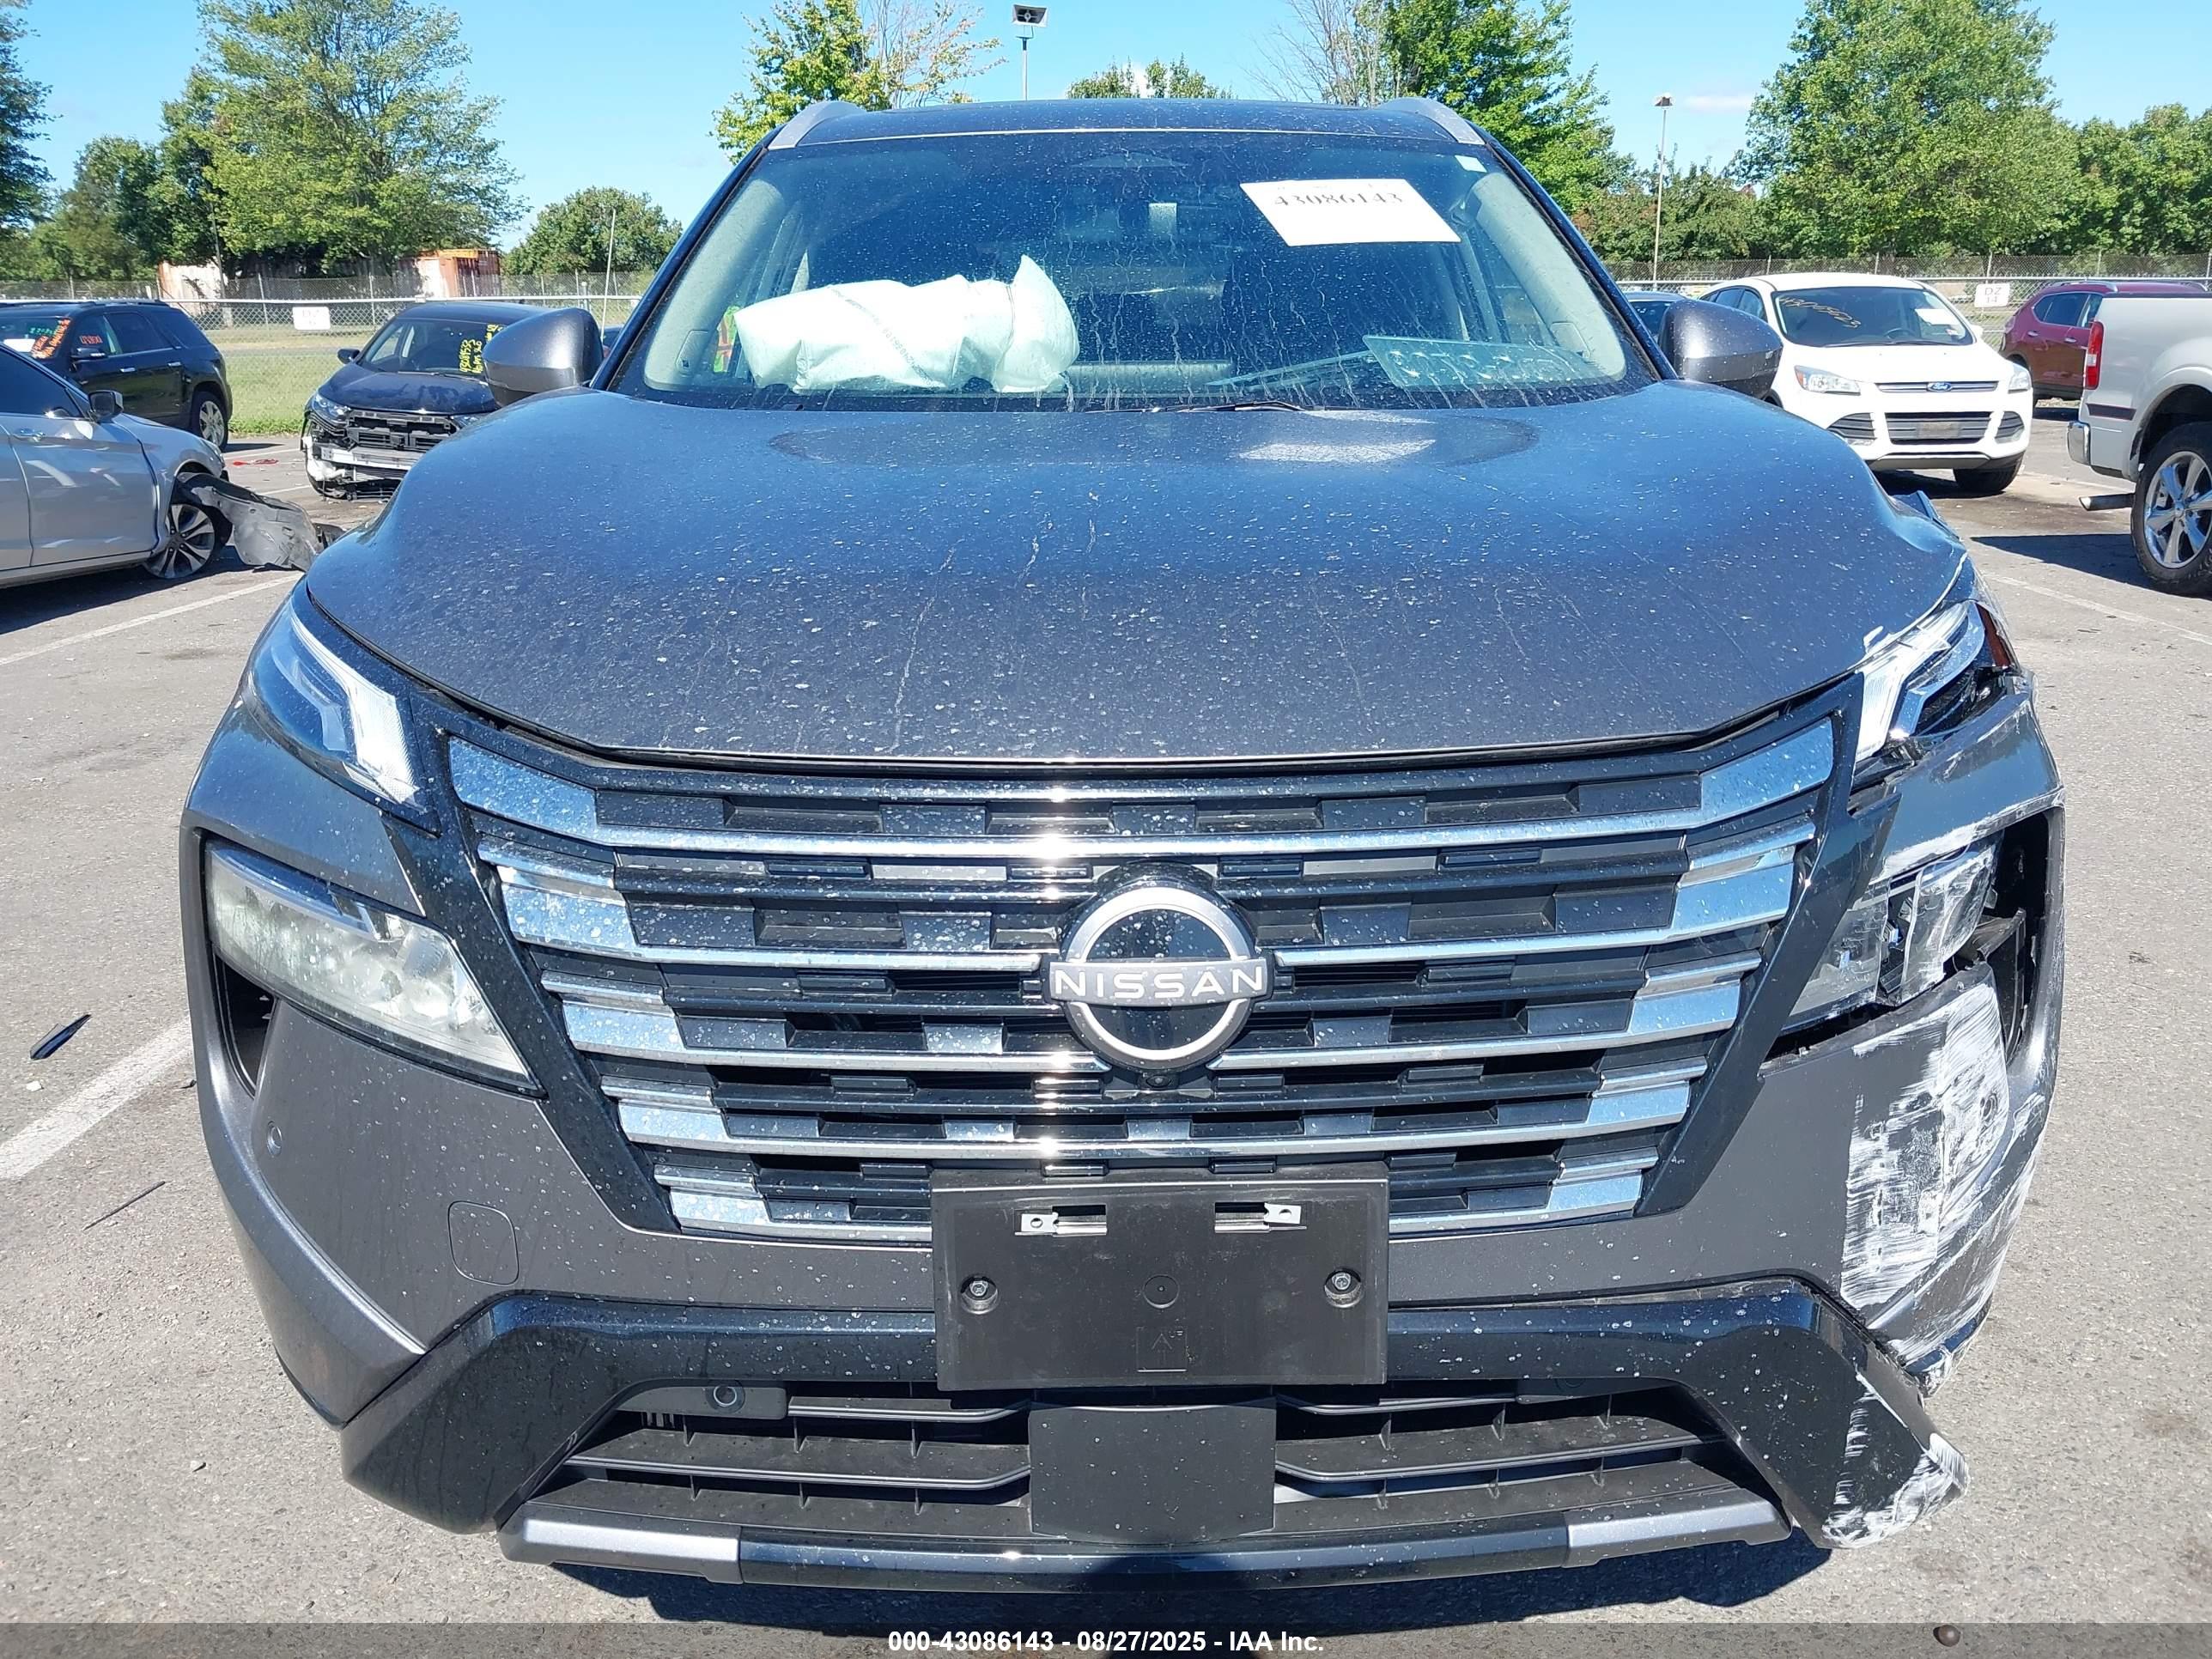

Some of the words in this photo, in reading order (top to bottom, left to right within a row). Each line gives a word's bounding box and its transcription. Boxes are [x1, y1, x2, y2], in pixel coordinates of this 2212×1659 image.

[1275, 192, 1403, 206] 43086143
[1984, 287, 2002, 295] DZ
[1054, 966, 1263, 1000] NISSAN
